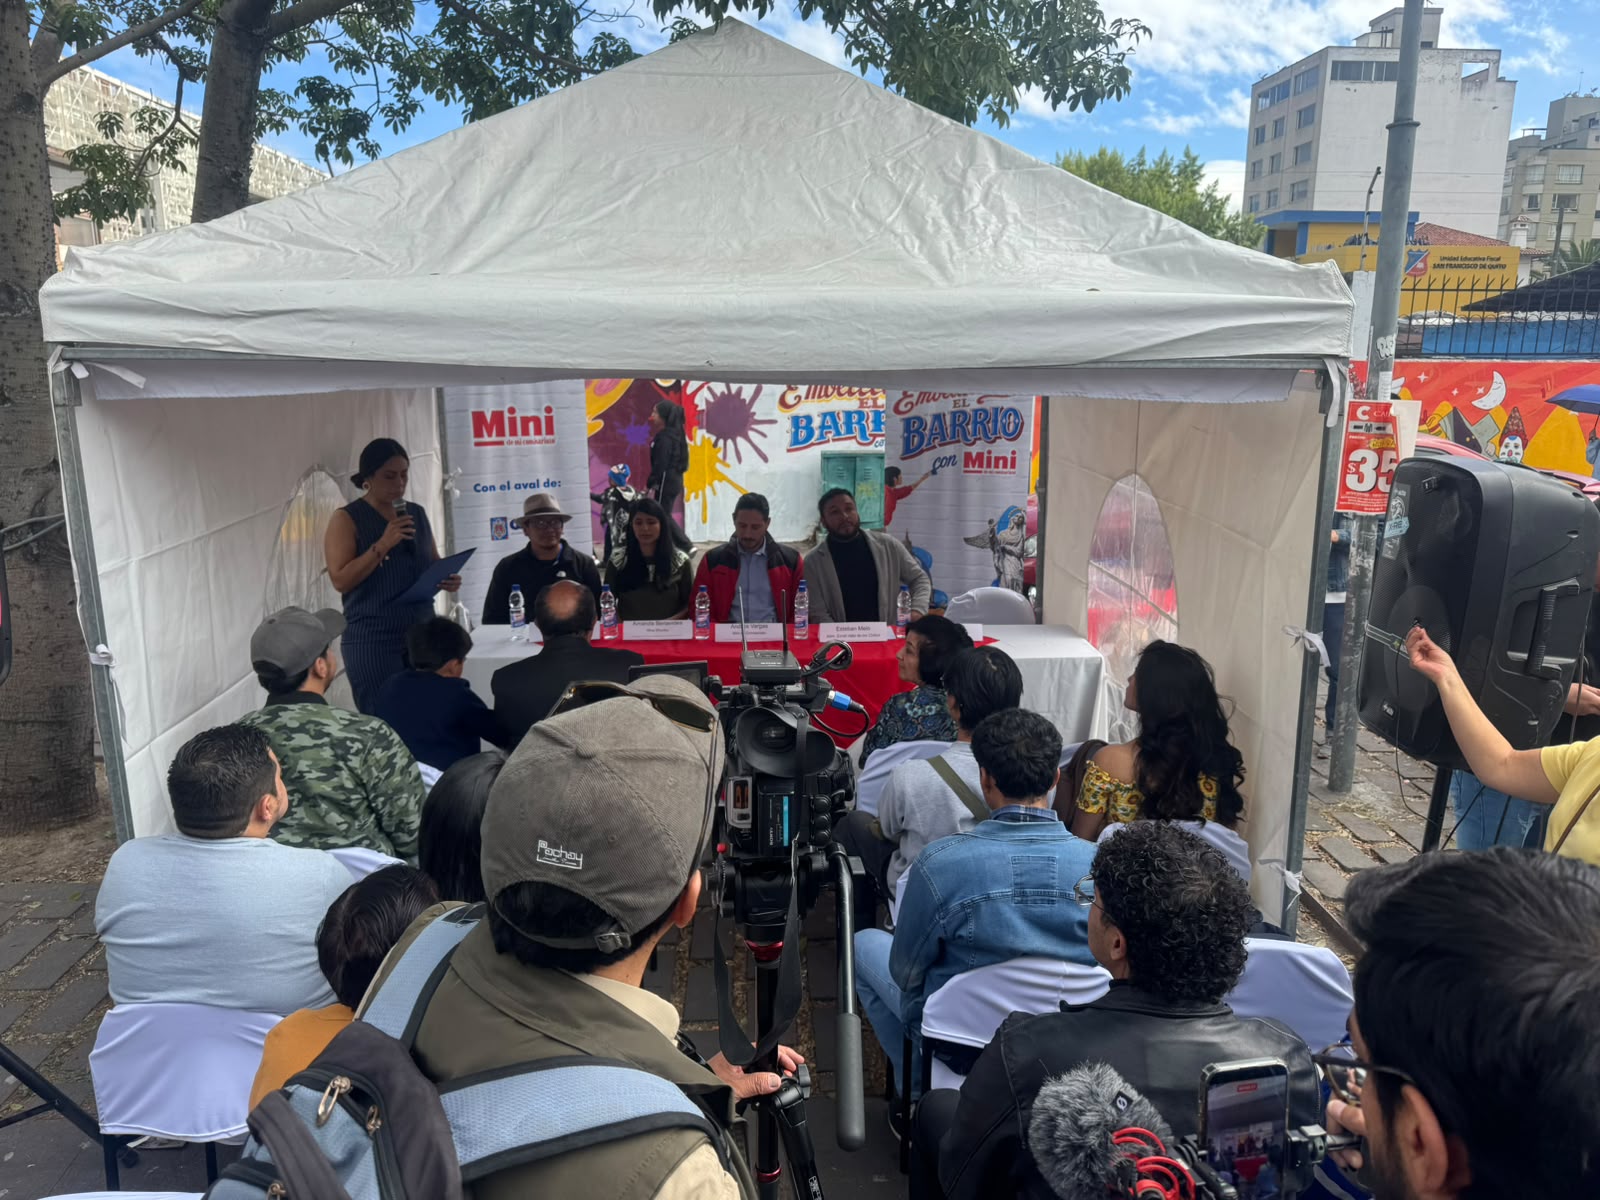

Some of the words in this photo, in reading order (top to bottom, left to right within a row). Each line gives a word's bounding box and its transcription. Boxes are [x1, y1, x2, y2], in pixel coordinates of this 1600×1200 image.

[858, 397, 885, 409] EL
[952, 398, 971, 409] EL
[471, 405, 555, 438] Mini
[900, 406, 1024, 459] BARRIO
[932, 454, 958, 473] con
[963, 449, 1017, 469] Mini
[473, 483, 496, 493] Con
[499, 480, 511, 491] el
[514, 479, 540, 489] aval
[543, 478, 562, 488] de:
